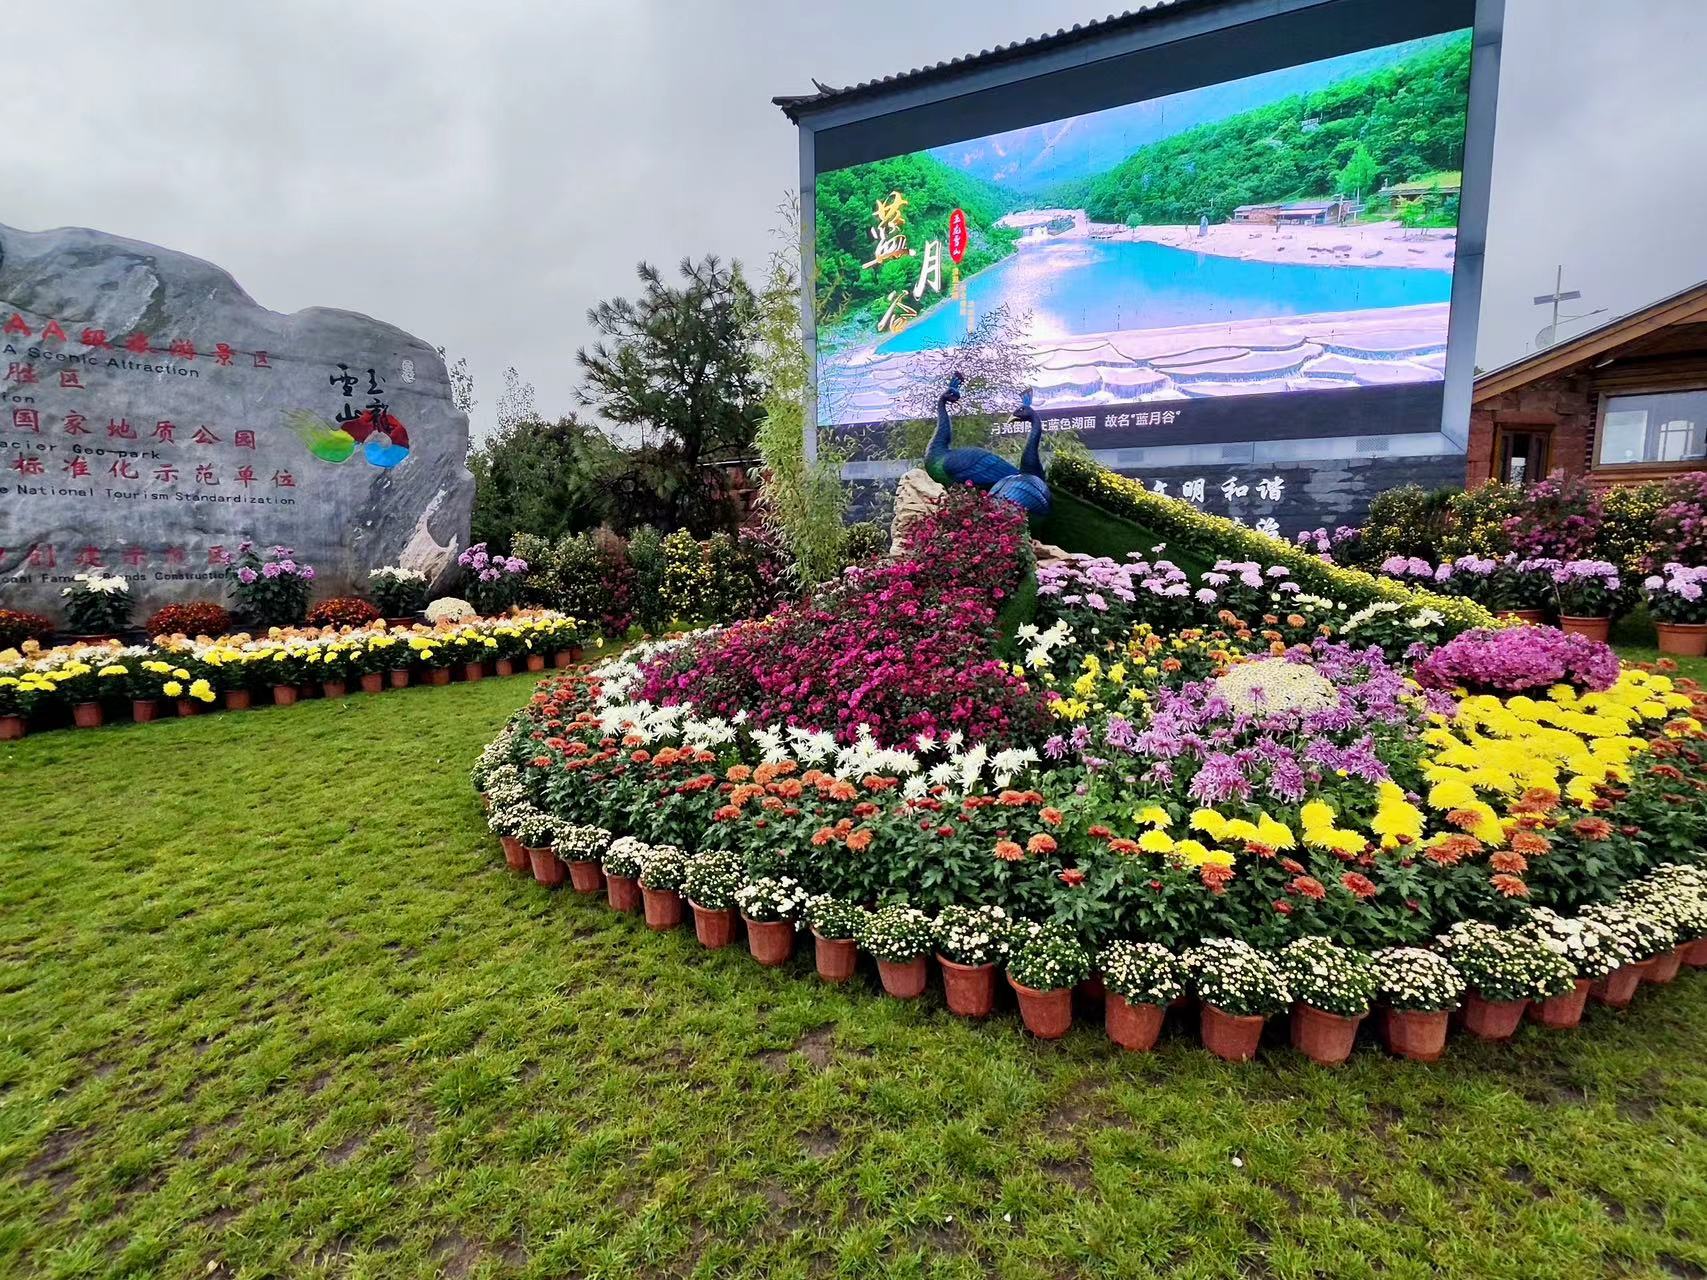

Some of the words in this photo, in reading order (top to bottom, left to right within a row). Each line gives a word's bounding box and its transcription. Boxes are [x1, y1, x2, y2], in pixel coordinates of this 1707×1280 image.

[4, 344, 17, 355] A
[27, 346, 98, 366] Scenic
[107, 357, 199, 378] Attraction
[12, 408, 256, 450] 国家地质公园
[72, 443, 161, 460] Geo-park
[10, 452, 296, 489] 标准化示范单位
[17, 484, 94, 497] National
[105, 488, 169, 501] Tourism
[175, 491, 296, 505] Standardization
